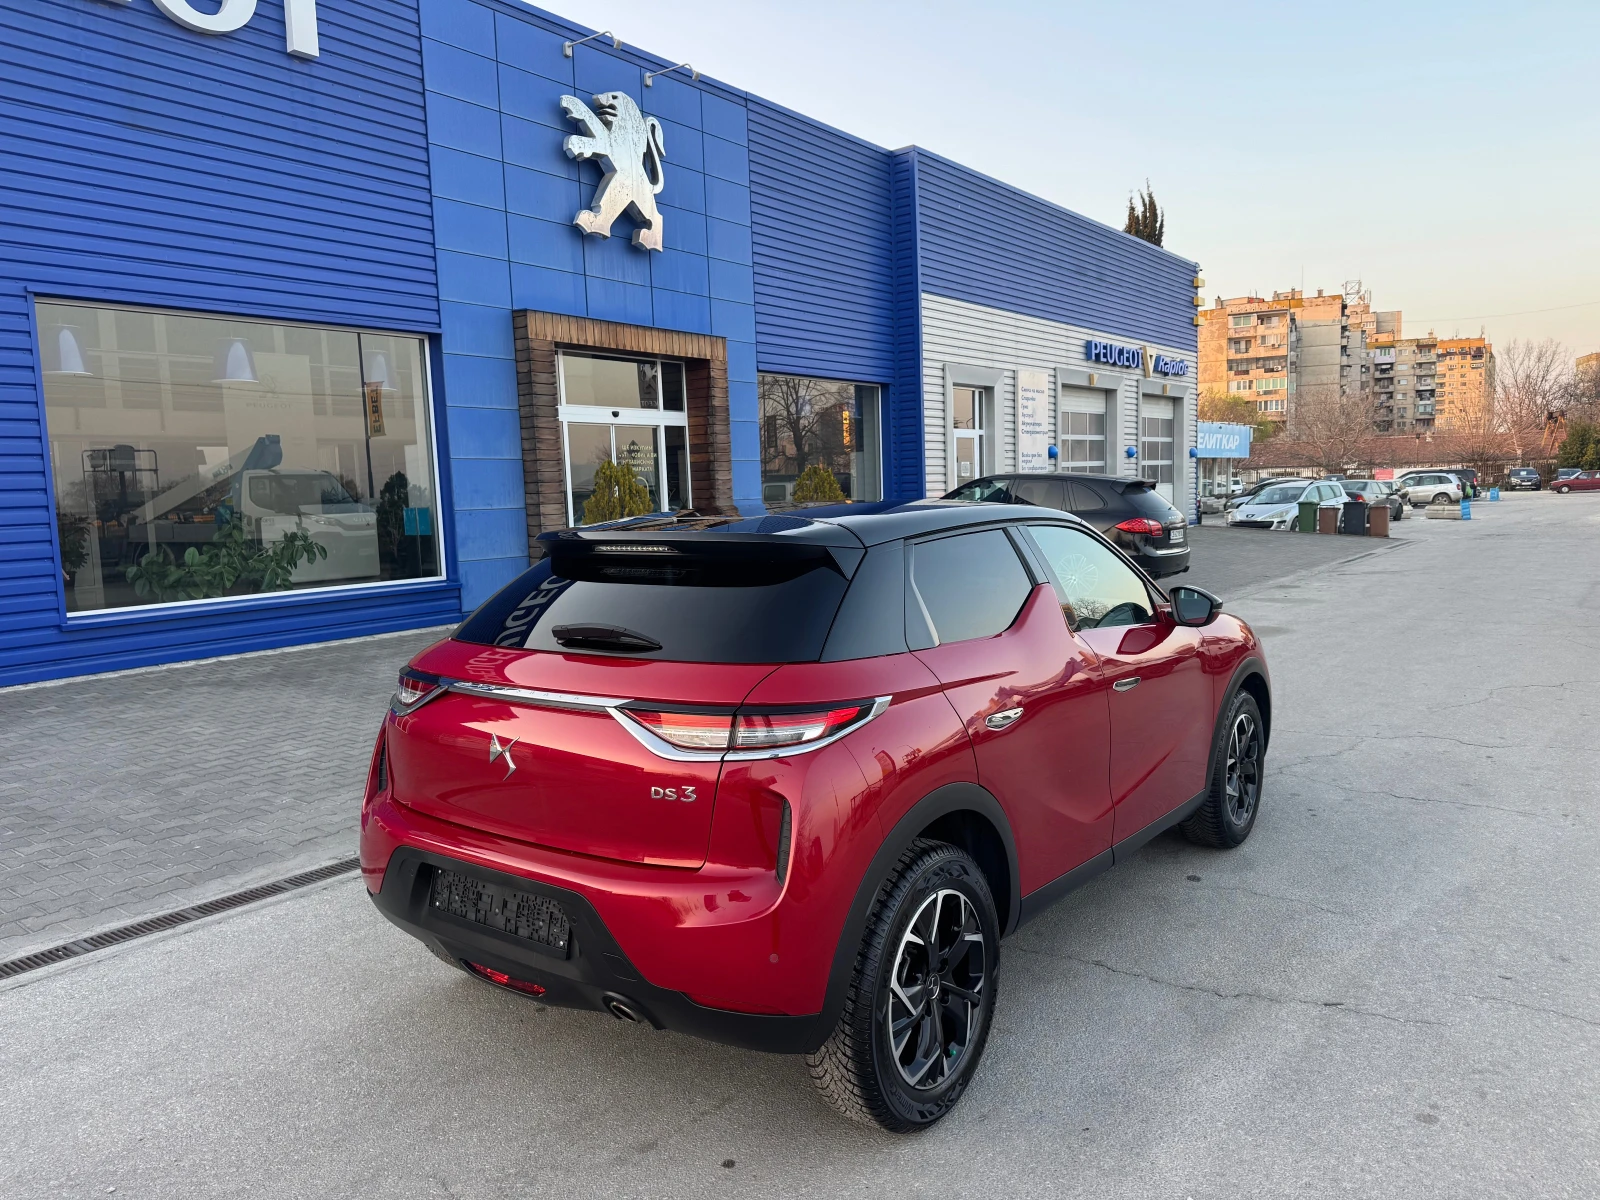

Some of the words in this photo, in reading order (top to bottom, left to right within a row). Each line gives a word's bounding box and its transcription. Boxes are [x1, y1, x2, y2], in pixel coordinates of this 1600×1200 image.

[1091, 340, 1143, 369] PEUGEOT
[1158, 356, 1189, 376] Rapide
[651, 786, 678, 801] DS
[680, 786, 697, 802] 3
